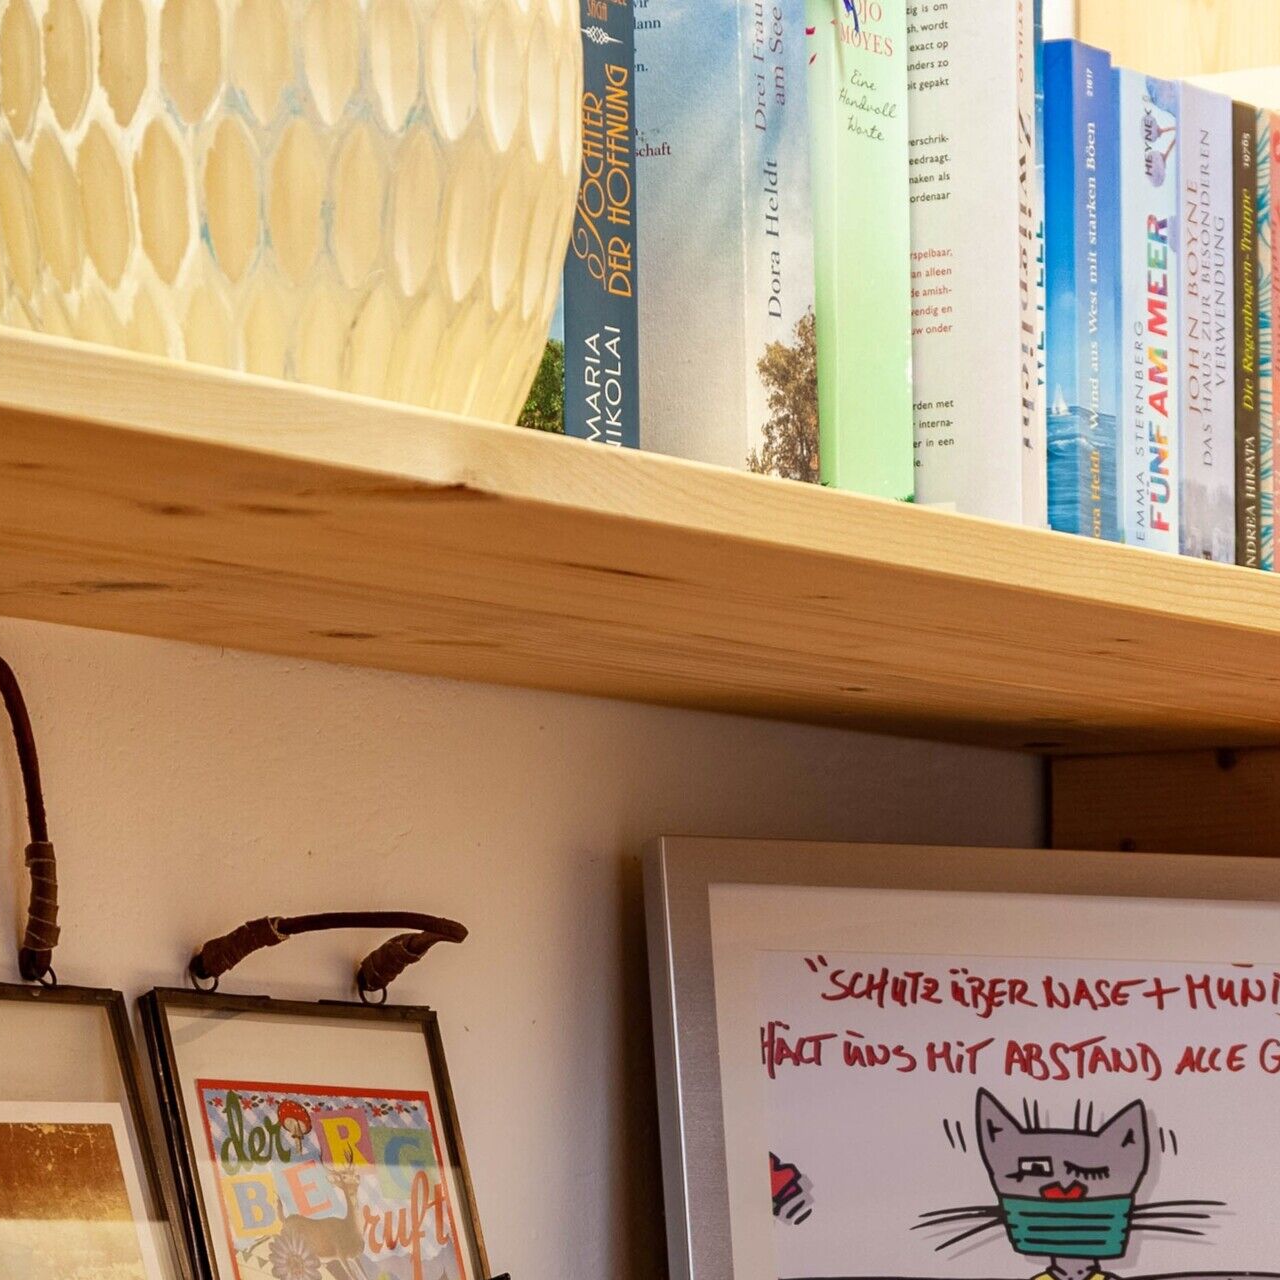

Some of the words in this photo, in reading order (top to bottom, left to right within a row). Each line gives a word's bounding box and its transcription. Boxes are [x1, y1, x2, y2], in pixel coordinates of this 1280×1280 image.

[921, 20, 948, 31] wordt
[933, 3, 948, 11] om
[769, 6, 784, 55] See
[839, 22, 894, 57] MOYES
[909, 42, 934, 52] exact
[936, 40, 949, 51] op
[849, 69, 878, 92] Eine
[919, 77, 950, 91] gepakt
[937, 59, 949, 68] zo
[753, 73, 767, 132] Drei
[774, 66, 786, 107] am
[838, 87, 897, 119] Handvoll
[605, 63, 631, 225] HOFFNUNG
[847, 115, 886, 142] Worte
[1085, 122, 1096, 172] Böen
[909, 192, 951, 203] ordenaar
[938, 171, 951, 181] als
[763, 160, 780, 237] Heldt
[1086, 178, 1097, 249] starken
[1200, 128, 1211, 286] BESONDEREN
[1186, 179, 1200, 298] BOYNE
[607, 236, 633, 298] DER
[768, 250, 783, 318] Dora
[925, 267, 952, 277] alleen
[1087, 250, 1098, 285] mit
[1145, 213, 1169, 336] MEER
[922, 284, 952, 297] amish-
[941, 305, 953, 314] en
[1214, 216, 1227, 388] VERWENDUNG
[925, 323, 953, 334] onder
[1087, 292, 1099, 335] West
[1201, 295, 1211, 342] ZUR
[1090, 342, 1101, 369] aus
[1187, 316, 1203, 415] JOHN
[584, 333, 602, 442] MARIA
[1089, 375, 1101, 430] Wind
[1133, 321, 1145, 457] STERNBERG
[1146, 346, 1169, 418] AM
[1201, 350, 1212, 413] HAUS
[1241, 379, 1255, 412] Die
[936, 400, 954, 409] met
[926, 438, 934, 447] in
[938, 438, 955, 446] een
[1202, 425, 1213, 467] DAS
[1147, 420, 1171, 533] FÜNF
[1243, 435, 1256, 499] HIRATA
[1135, 471, 1146, 542] EMMA
[1041, 974, 1148, 1011] NASE
[1004, 1035, 1163, 1081] ABSTAND
[220, 1089, 292, 1176] der
